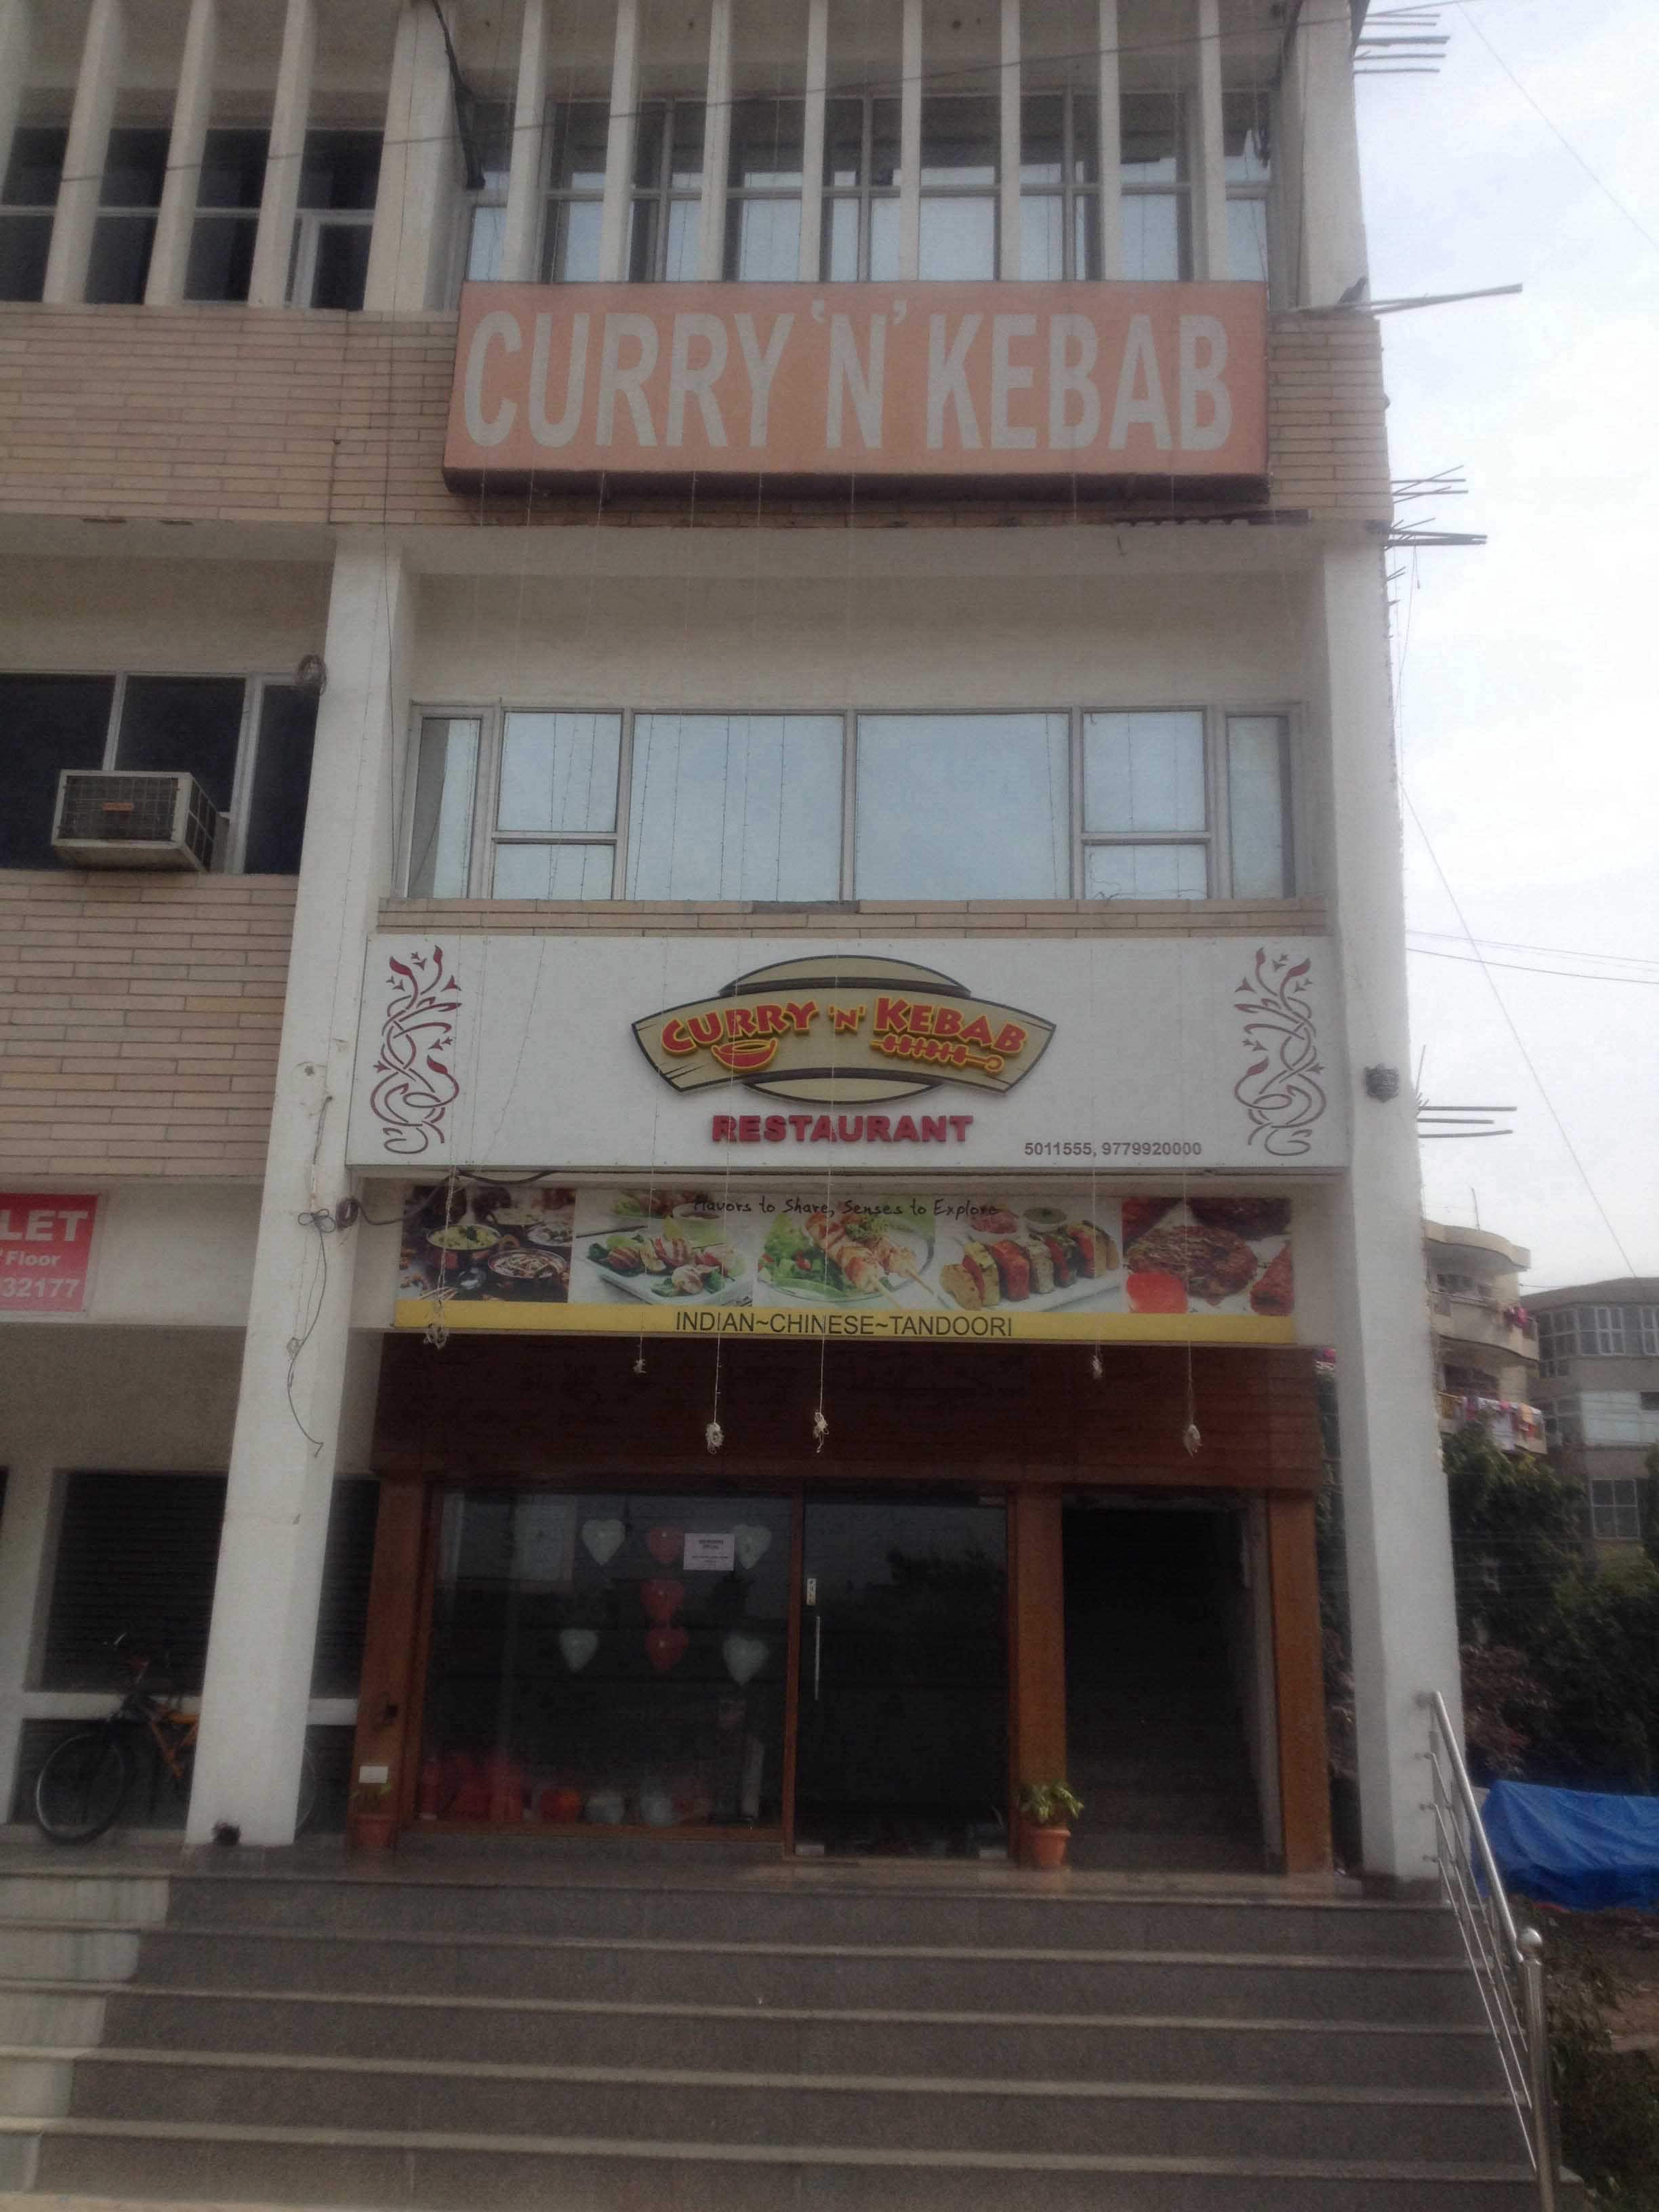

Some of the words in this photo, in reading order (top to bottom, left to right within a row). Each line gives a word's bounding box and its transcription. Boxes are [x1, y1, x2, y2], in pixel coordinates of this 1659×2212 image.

[463, 310, 795, 448] CURRY
[924, 312, 1233, 451] KEBAB
[661, 1000, 819, 1056] CURRY
[874, 996, 1029, 1054] KEBAB
[712, 1114, 975, 1143] RESTAURANT
[1024, 1142, 1097, 1158] 5011555,
[1101, 1142, 1203, 1156] 9779920000
[758, 1195, 776, 1214] to
[782, 1197, 835, 1218] Share,
[841, 1200, 903, 1215] Senses
[910, 1197, 927, 1216] to
[933, 1198, 1000, 1221] Explore
[0, 1209, 89, 1242] LET
[5, 1250, 61, 1267] Floor
